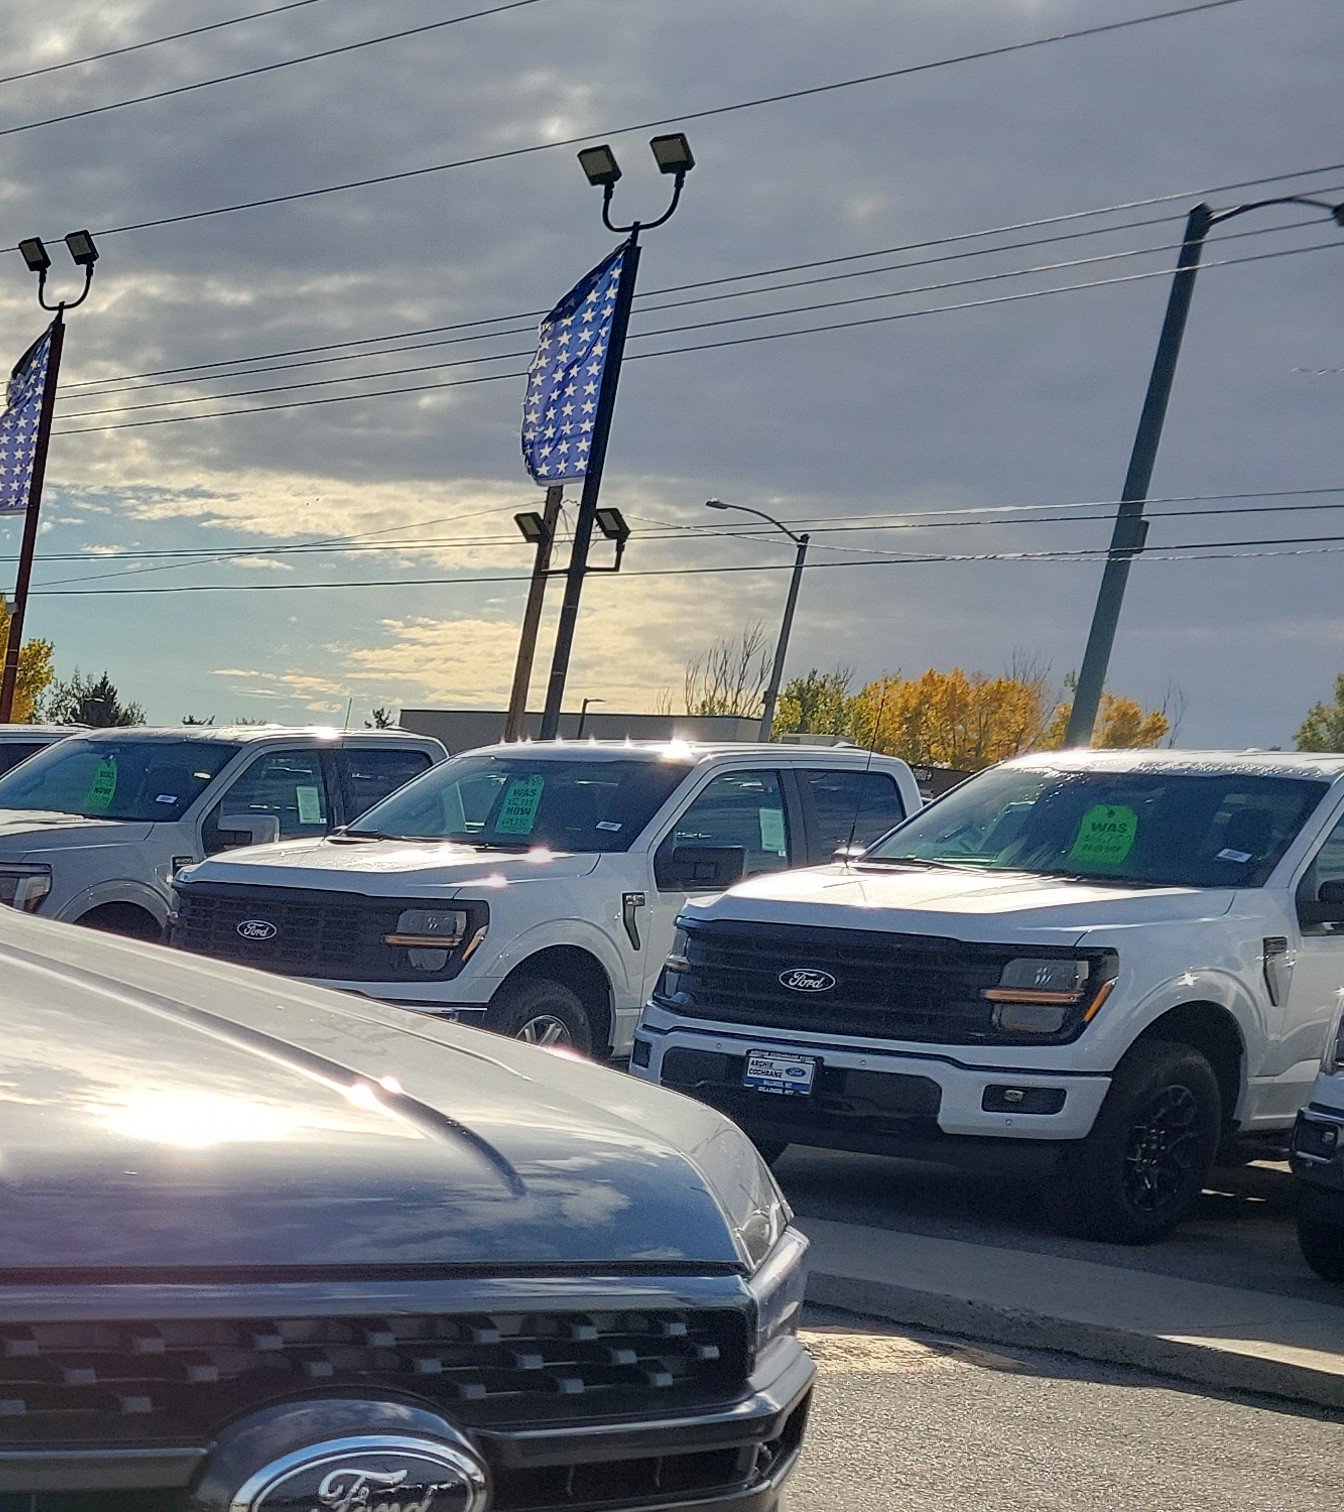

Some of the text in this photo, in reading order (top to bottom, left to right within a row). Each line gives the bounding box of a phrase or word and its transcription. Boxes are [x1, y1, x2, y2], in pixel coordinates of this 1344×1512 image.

[1091, 822, 1128, 834] WAS
[243, 922, 270, 937] Ford
[788, 971, 826, 989] Ford
